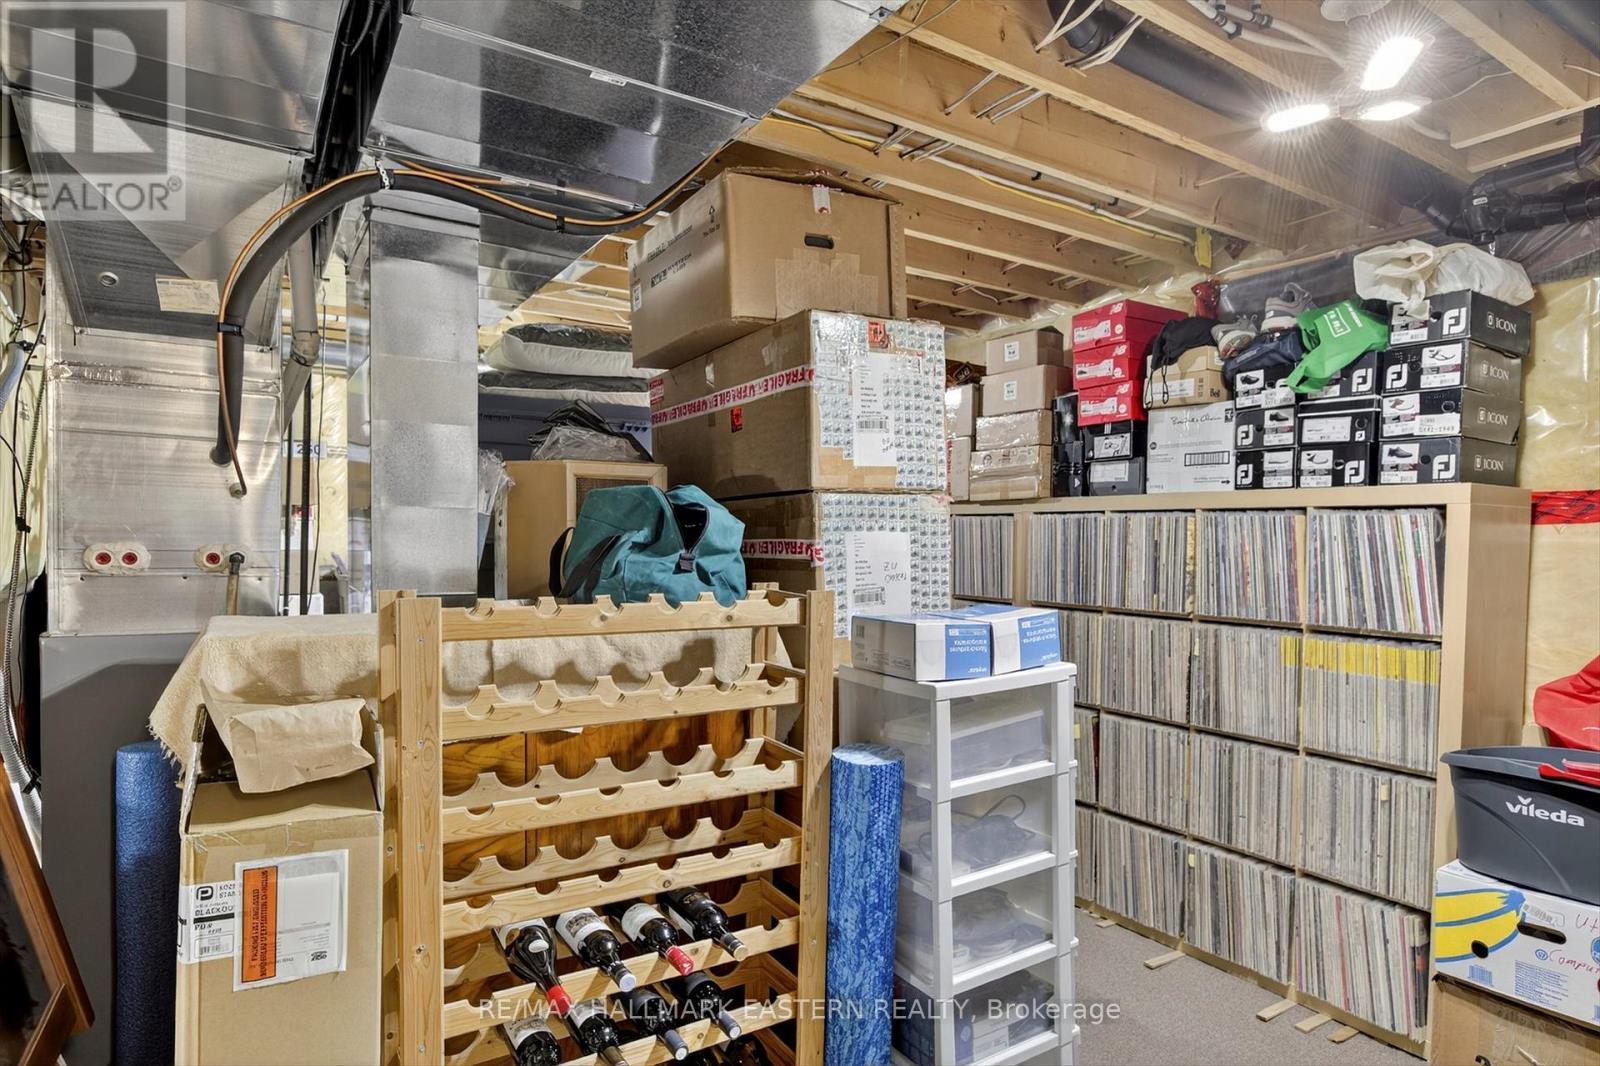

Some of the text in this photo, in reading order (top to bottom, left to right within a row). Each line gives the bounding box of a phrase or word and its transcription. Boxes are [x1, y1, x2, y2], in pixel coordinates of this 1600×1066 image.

[1442, 307, 1467, 335] FJ
[1495, 317, 1517, 334] ICON
[1352, 368, 1373, 392] FJ
[1386, 363, 1408, 389] FJ
[1489, 366, 1510, 380] ICON
[1486, 412, 1509, 425] ICON
[1237, 425, 1254, 447] FJ
[1237, 464, 1254, 485] FJ
[1344, 460, 1365, 484] FJ
[1432, 454, 1456, 480] FJ
[1484, 458, 1504, 471] ICON
[1505, 795, 1585, 827] vileda
